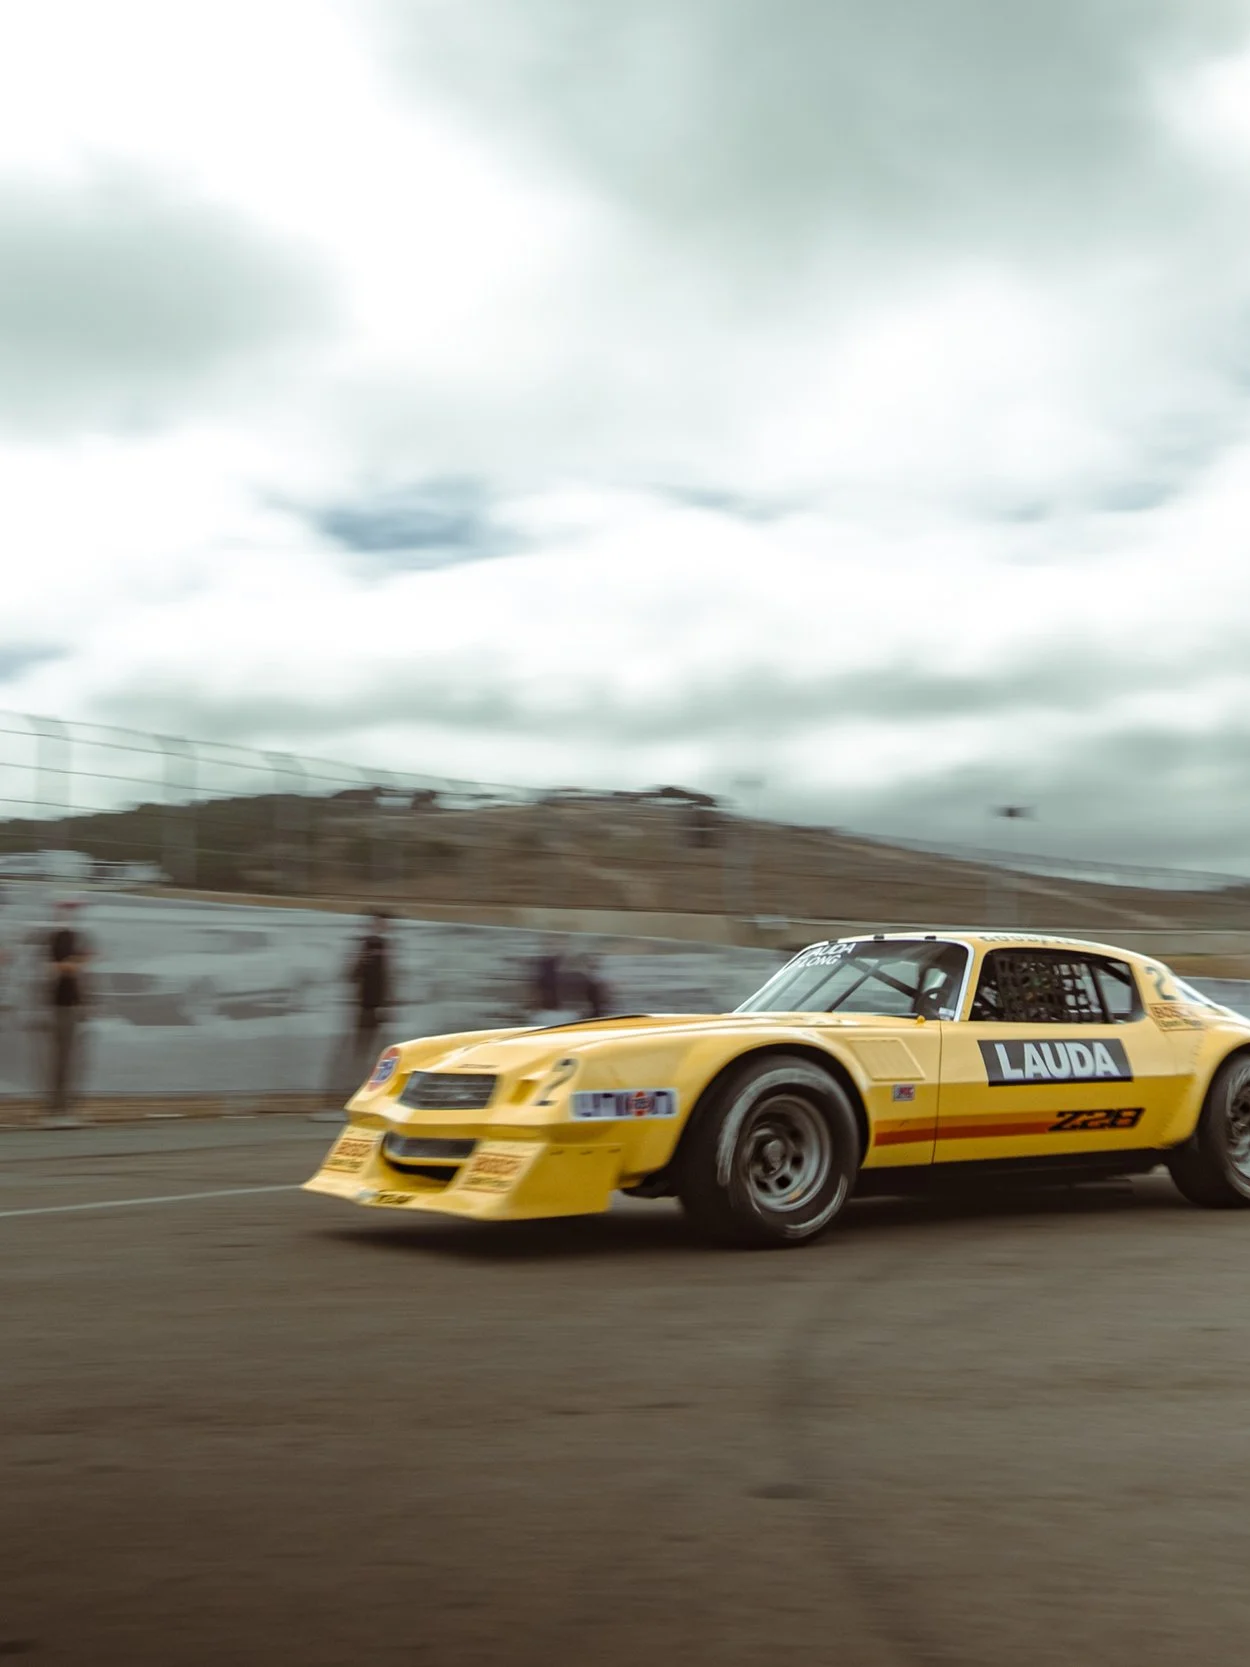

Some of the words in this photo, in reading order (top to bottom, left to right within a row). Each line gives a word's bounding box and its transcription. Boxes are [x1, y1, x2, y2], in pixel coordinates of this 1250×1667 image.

[1144, 966, 1178, 1001] 2
[994, 1042, 1121, 1079] LAUDA
[535, 1058, 580, 1107] 2
[1048, 1108, 1146, 1132] Z28
